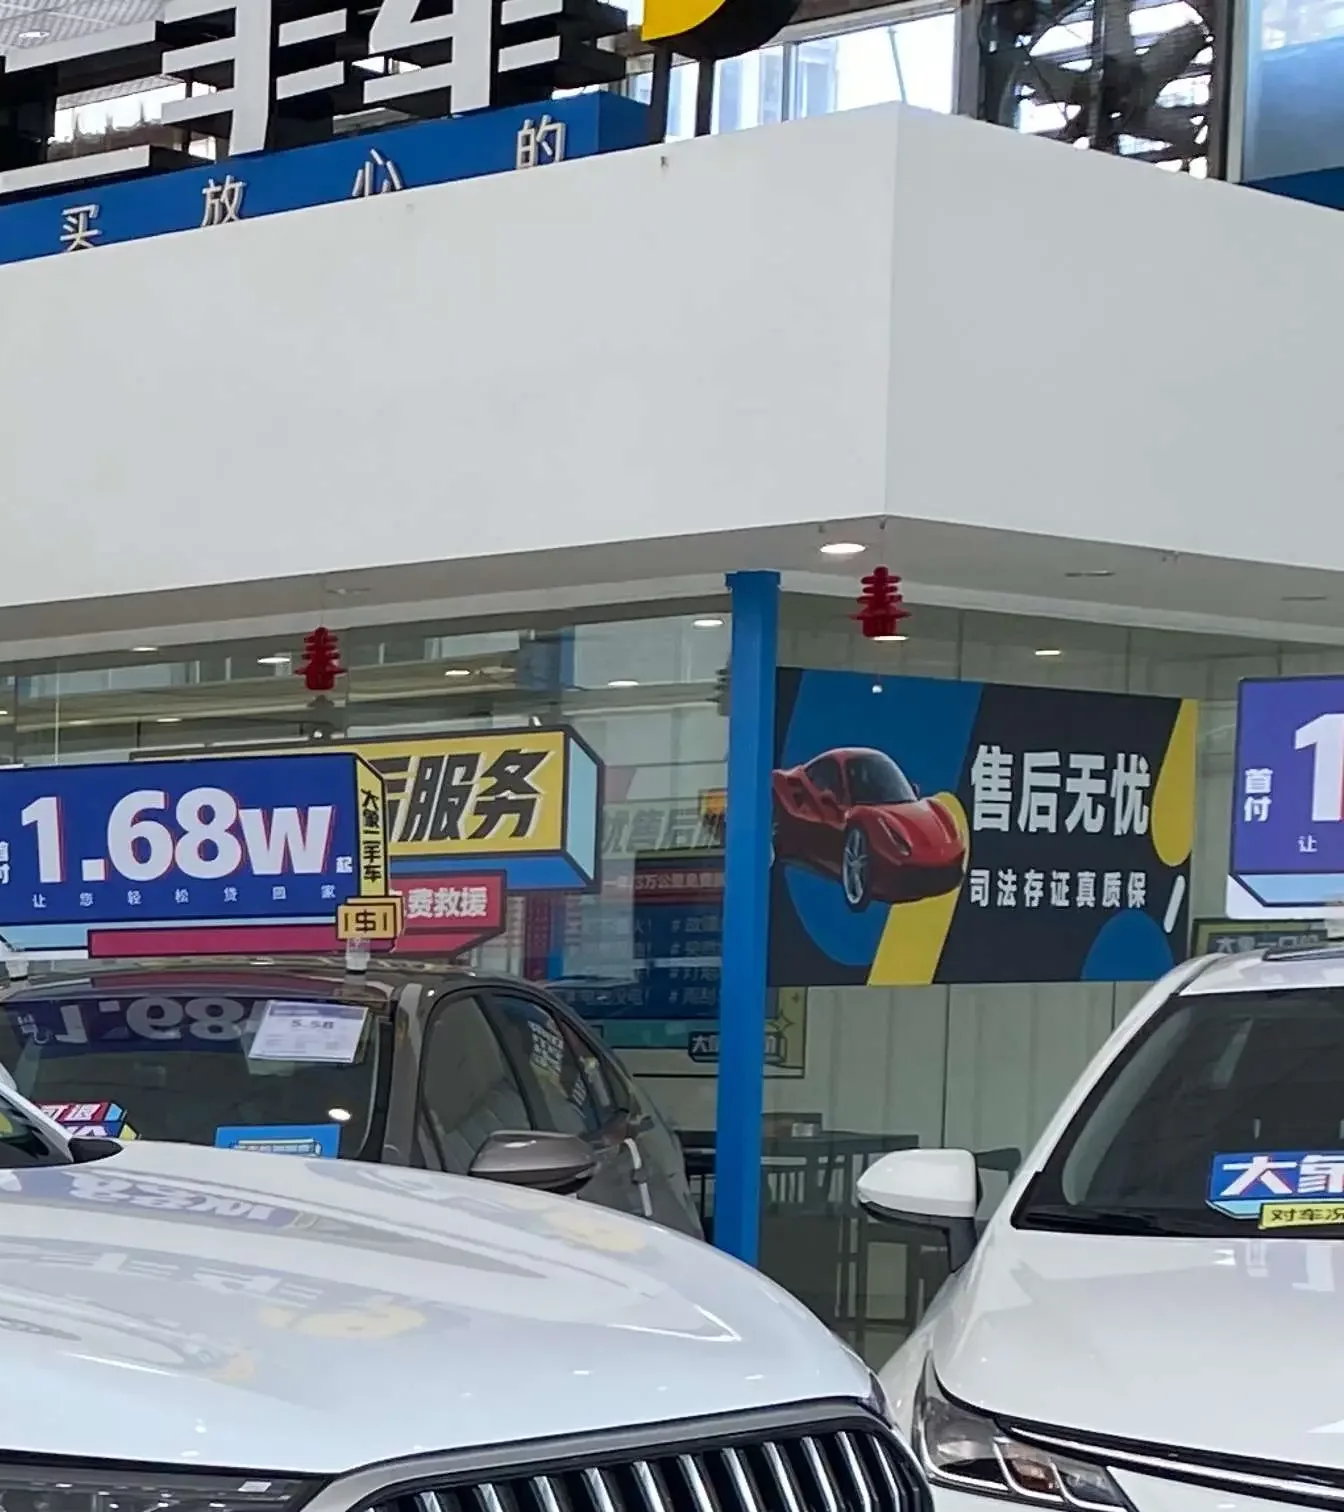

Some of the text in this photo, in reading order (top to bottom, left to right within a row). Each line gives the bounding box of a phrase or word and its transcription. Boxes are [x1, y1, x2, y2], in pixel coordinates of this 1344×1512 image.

[970, 745, 1151, 836] 售后无忧
[1244, 768, 1273, 822] 首付
[32, 884, 337, 909] 让您轻松贷回家
[390, 885, 488, 918] 费救援
[971, 869, 1147, 908] 司法存证真质保
